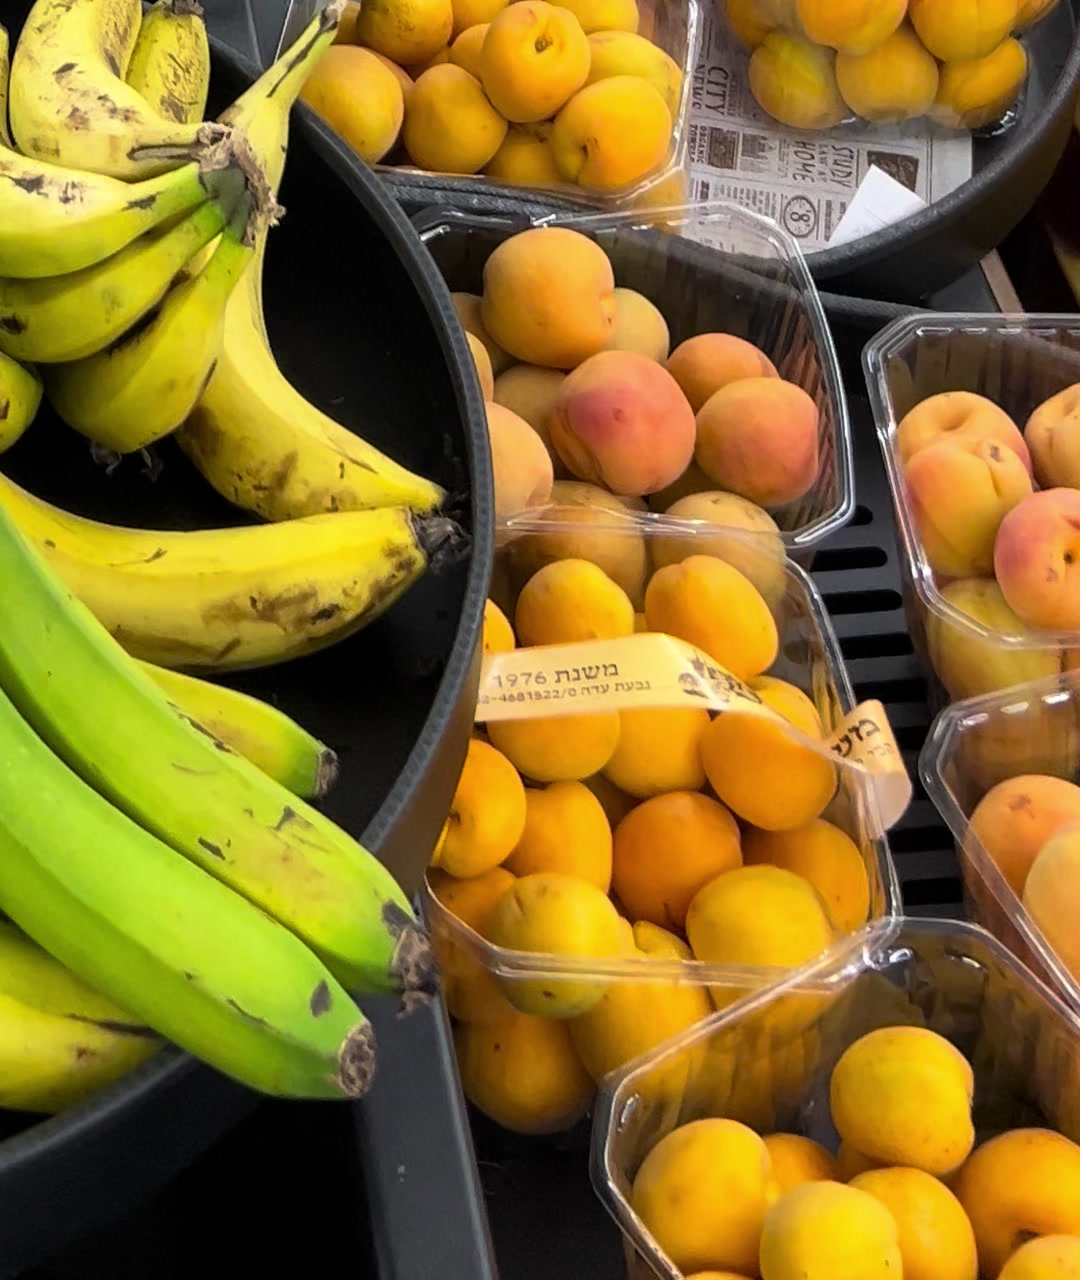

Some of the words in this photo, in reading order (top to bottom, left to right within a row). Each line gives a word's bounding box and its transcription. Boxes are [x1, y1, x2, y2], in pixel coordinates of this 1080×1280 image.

[706, 65, 729, 117] CITY
[792, 140, 817, 184] HOME
[831, 144, 855, 188] STUDY
[492, 670, 548, 689] 1976
[554, 662, 619, 684] משנת
